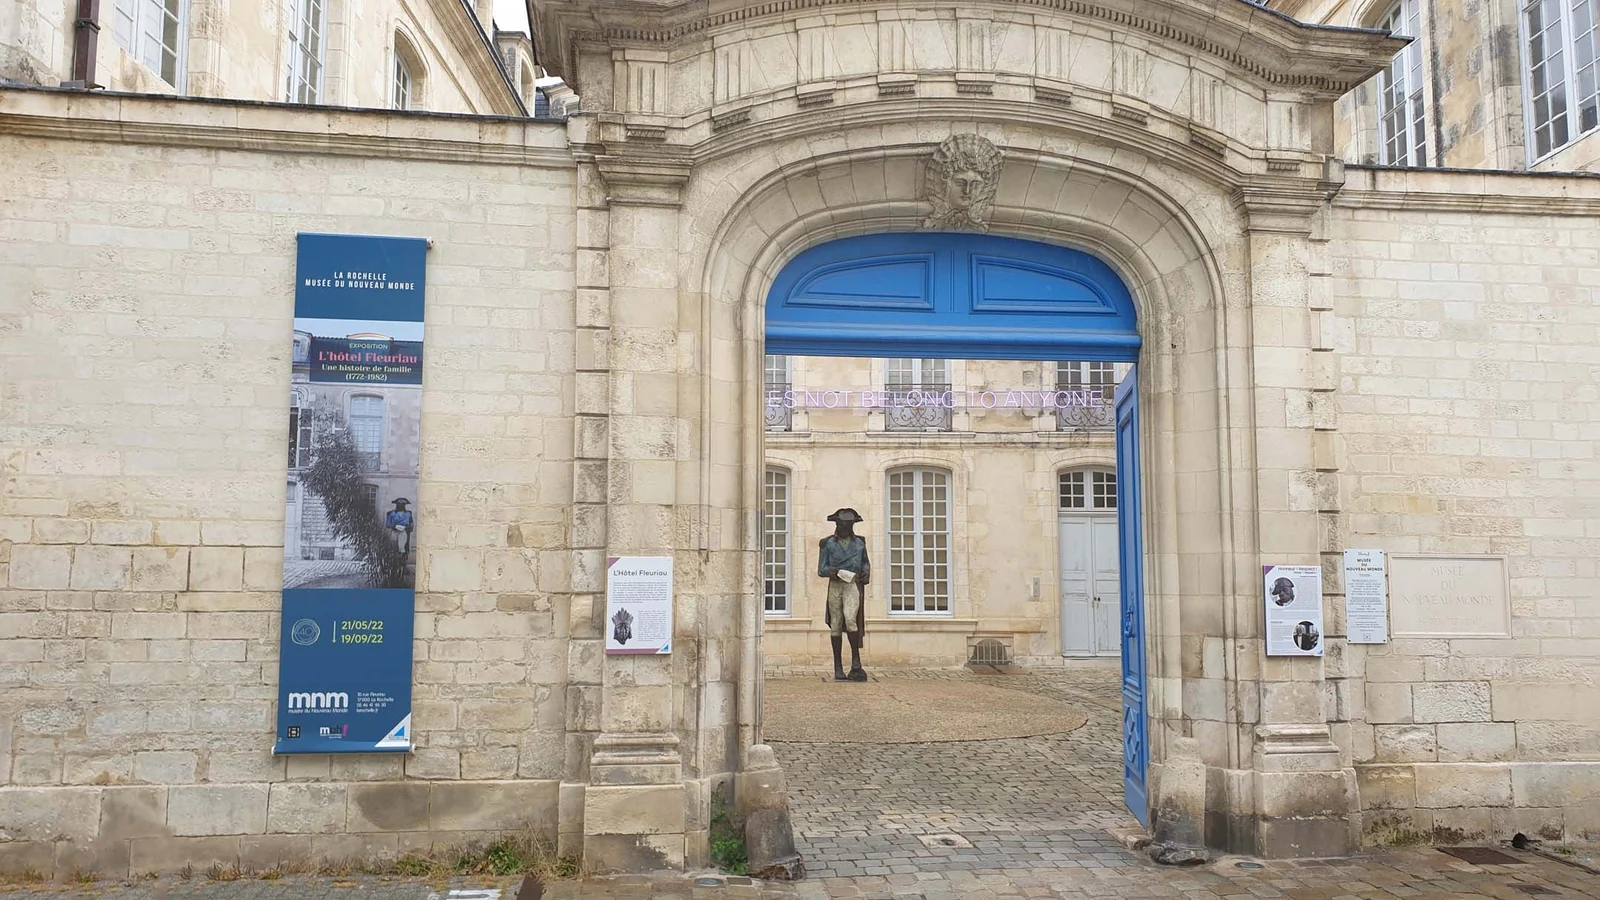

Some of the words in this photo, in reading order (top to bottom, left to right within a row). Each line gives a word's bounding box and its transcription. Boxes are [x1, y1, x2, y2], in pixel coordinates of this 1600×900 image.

[333, 271, 344, 279] LA
[347, 272, 387, 281] ROCHELLE
[305, 278, 331, 287] MUSÉE
[335, 280, 345, 288] DU
[348, 280, 385, 289] NOUVEAU
[388, 282, 415, 290] MONDE
[319, 351, 361, 362] L'hôtel
[365, 352, 418, 364] Fleuriau
[322, 363, 338, 371] Une
[339, 363, 371, 372] histoire
[372, 364, 382, 373] de
[384, 365, 412, 373] famille
[345, 373, 388, 382] (1772-1982)
[805, 390, 852, 408] NOT
[862, 390, 957, 409] BELONG
[966, 390, 998, 409] TO
[1003, 390, 1104, 409] ANYONE
[613, 569, 638, 577] L'Hôtel
[639, 569, 668, 577] Fleuriau
[341, 621, 384, 631] 21/05/22
[341, 634, 384, 644] 19/09/22
[288, 692, 349, 709] mnm
